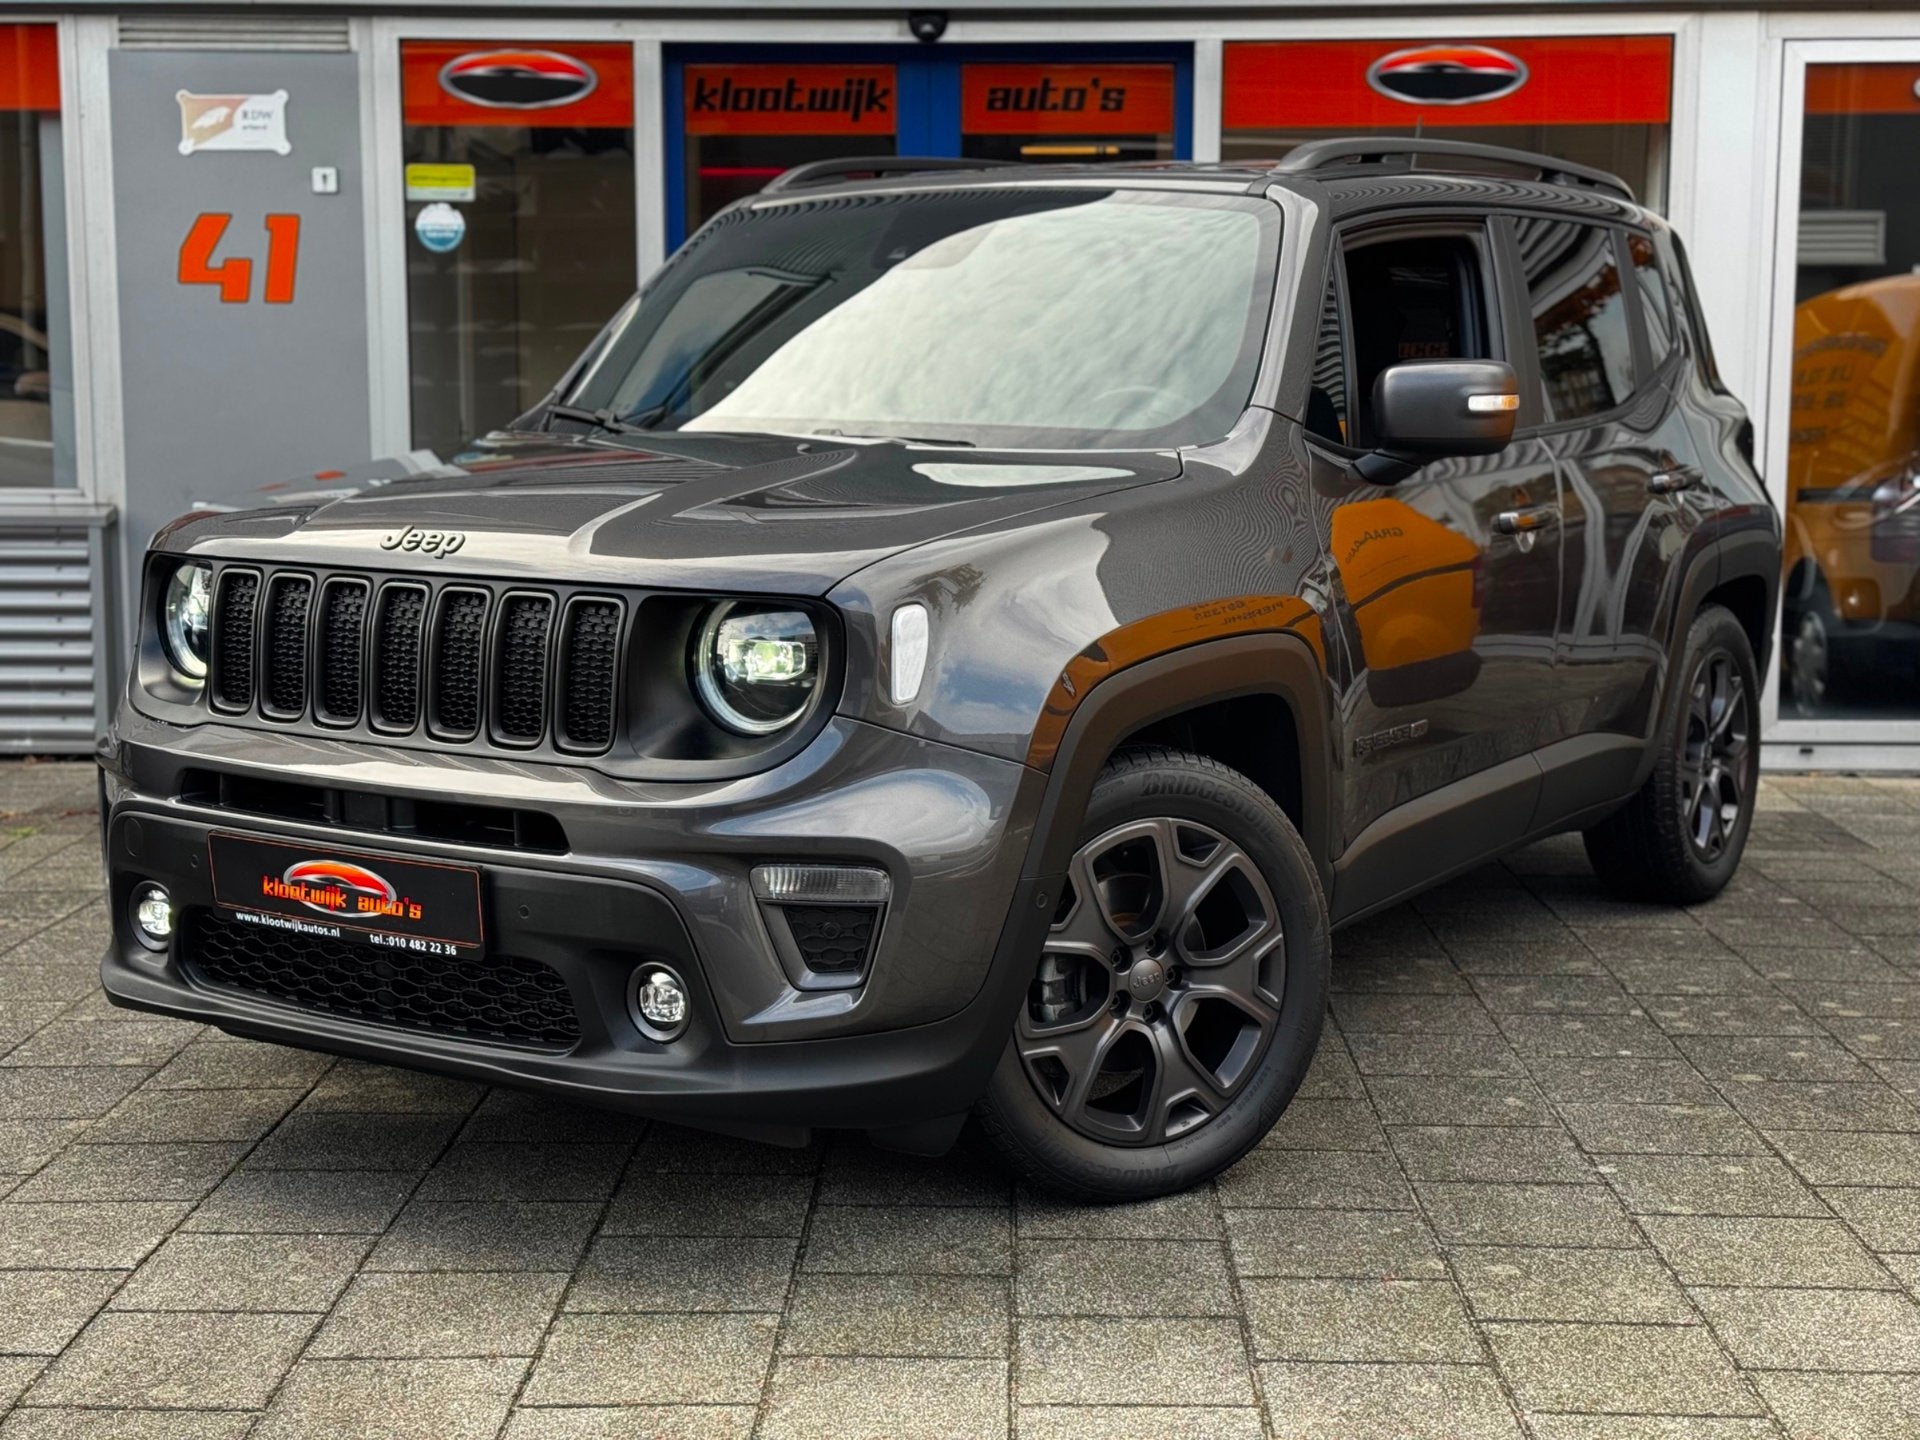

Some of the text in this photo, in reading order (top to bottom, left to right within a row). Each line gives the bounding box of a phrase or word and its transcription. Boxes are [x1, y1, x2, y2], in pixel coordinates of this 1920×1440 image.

[692, 76, 1127, 122] klootwijk auto's
[178, 212, 301, 304] 41
[380, 525, 466, 560] Jeep
[262, 875, 422, 920] klootwijk auto's
[235, 911, 341, 938] www.klootwijkautos.nl
[409, 939, 427, 952] 482
[429, 942, 442, 954] 22
[444, 944, 457, 956] 36
